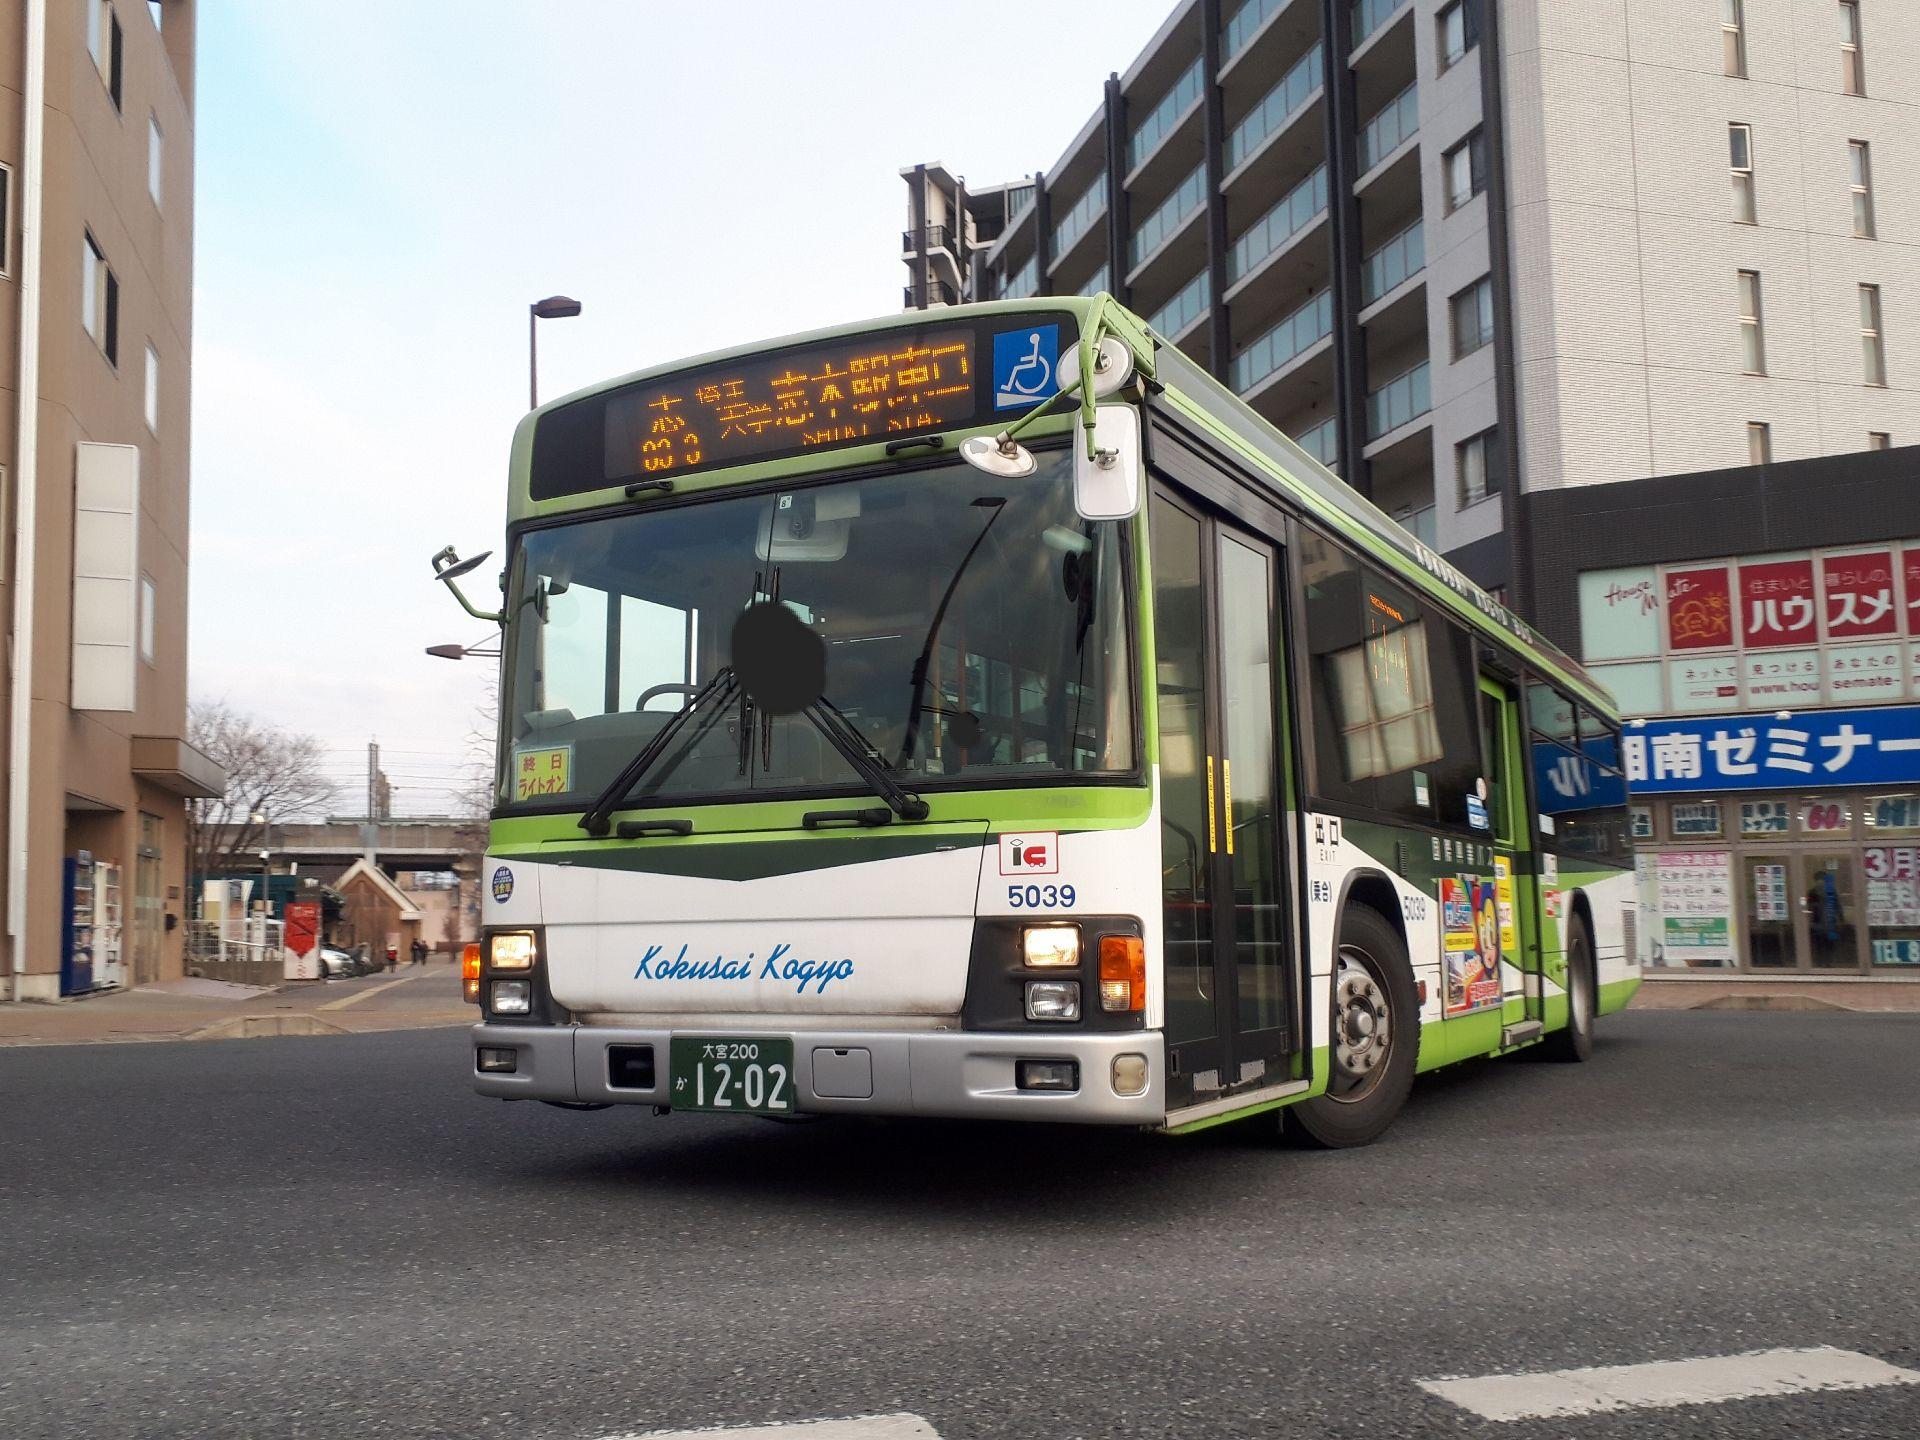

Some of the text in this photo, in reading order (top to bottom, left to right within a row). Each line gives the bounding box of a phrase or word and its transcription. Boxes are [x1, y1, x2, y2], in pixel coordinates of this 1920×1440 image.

[519, 775, 565, 796] ライトオン
[1314, 816, 1339, 846] 出口
[1008, 884, 1076, 908] 5039
[633, 943, 855, 994] Kokusai Kogyo
[675, 1061, 788, 1109] か 12-02
